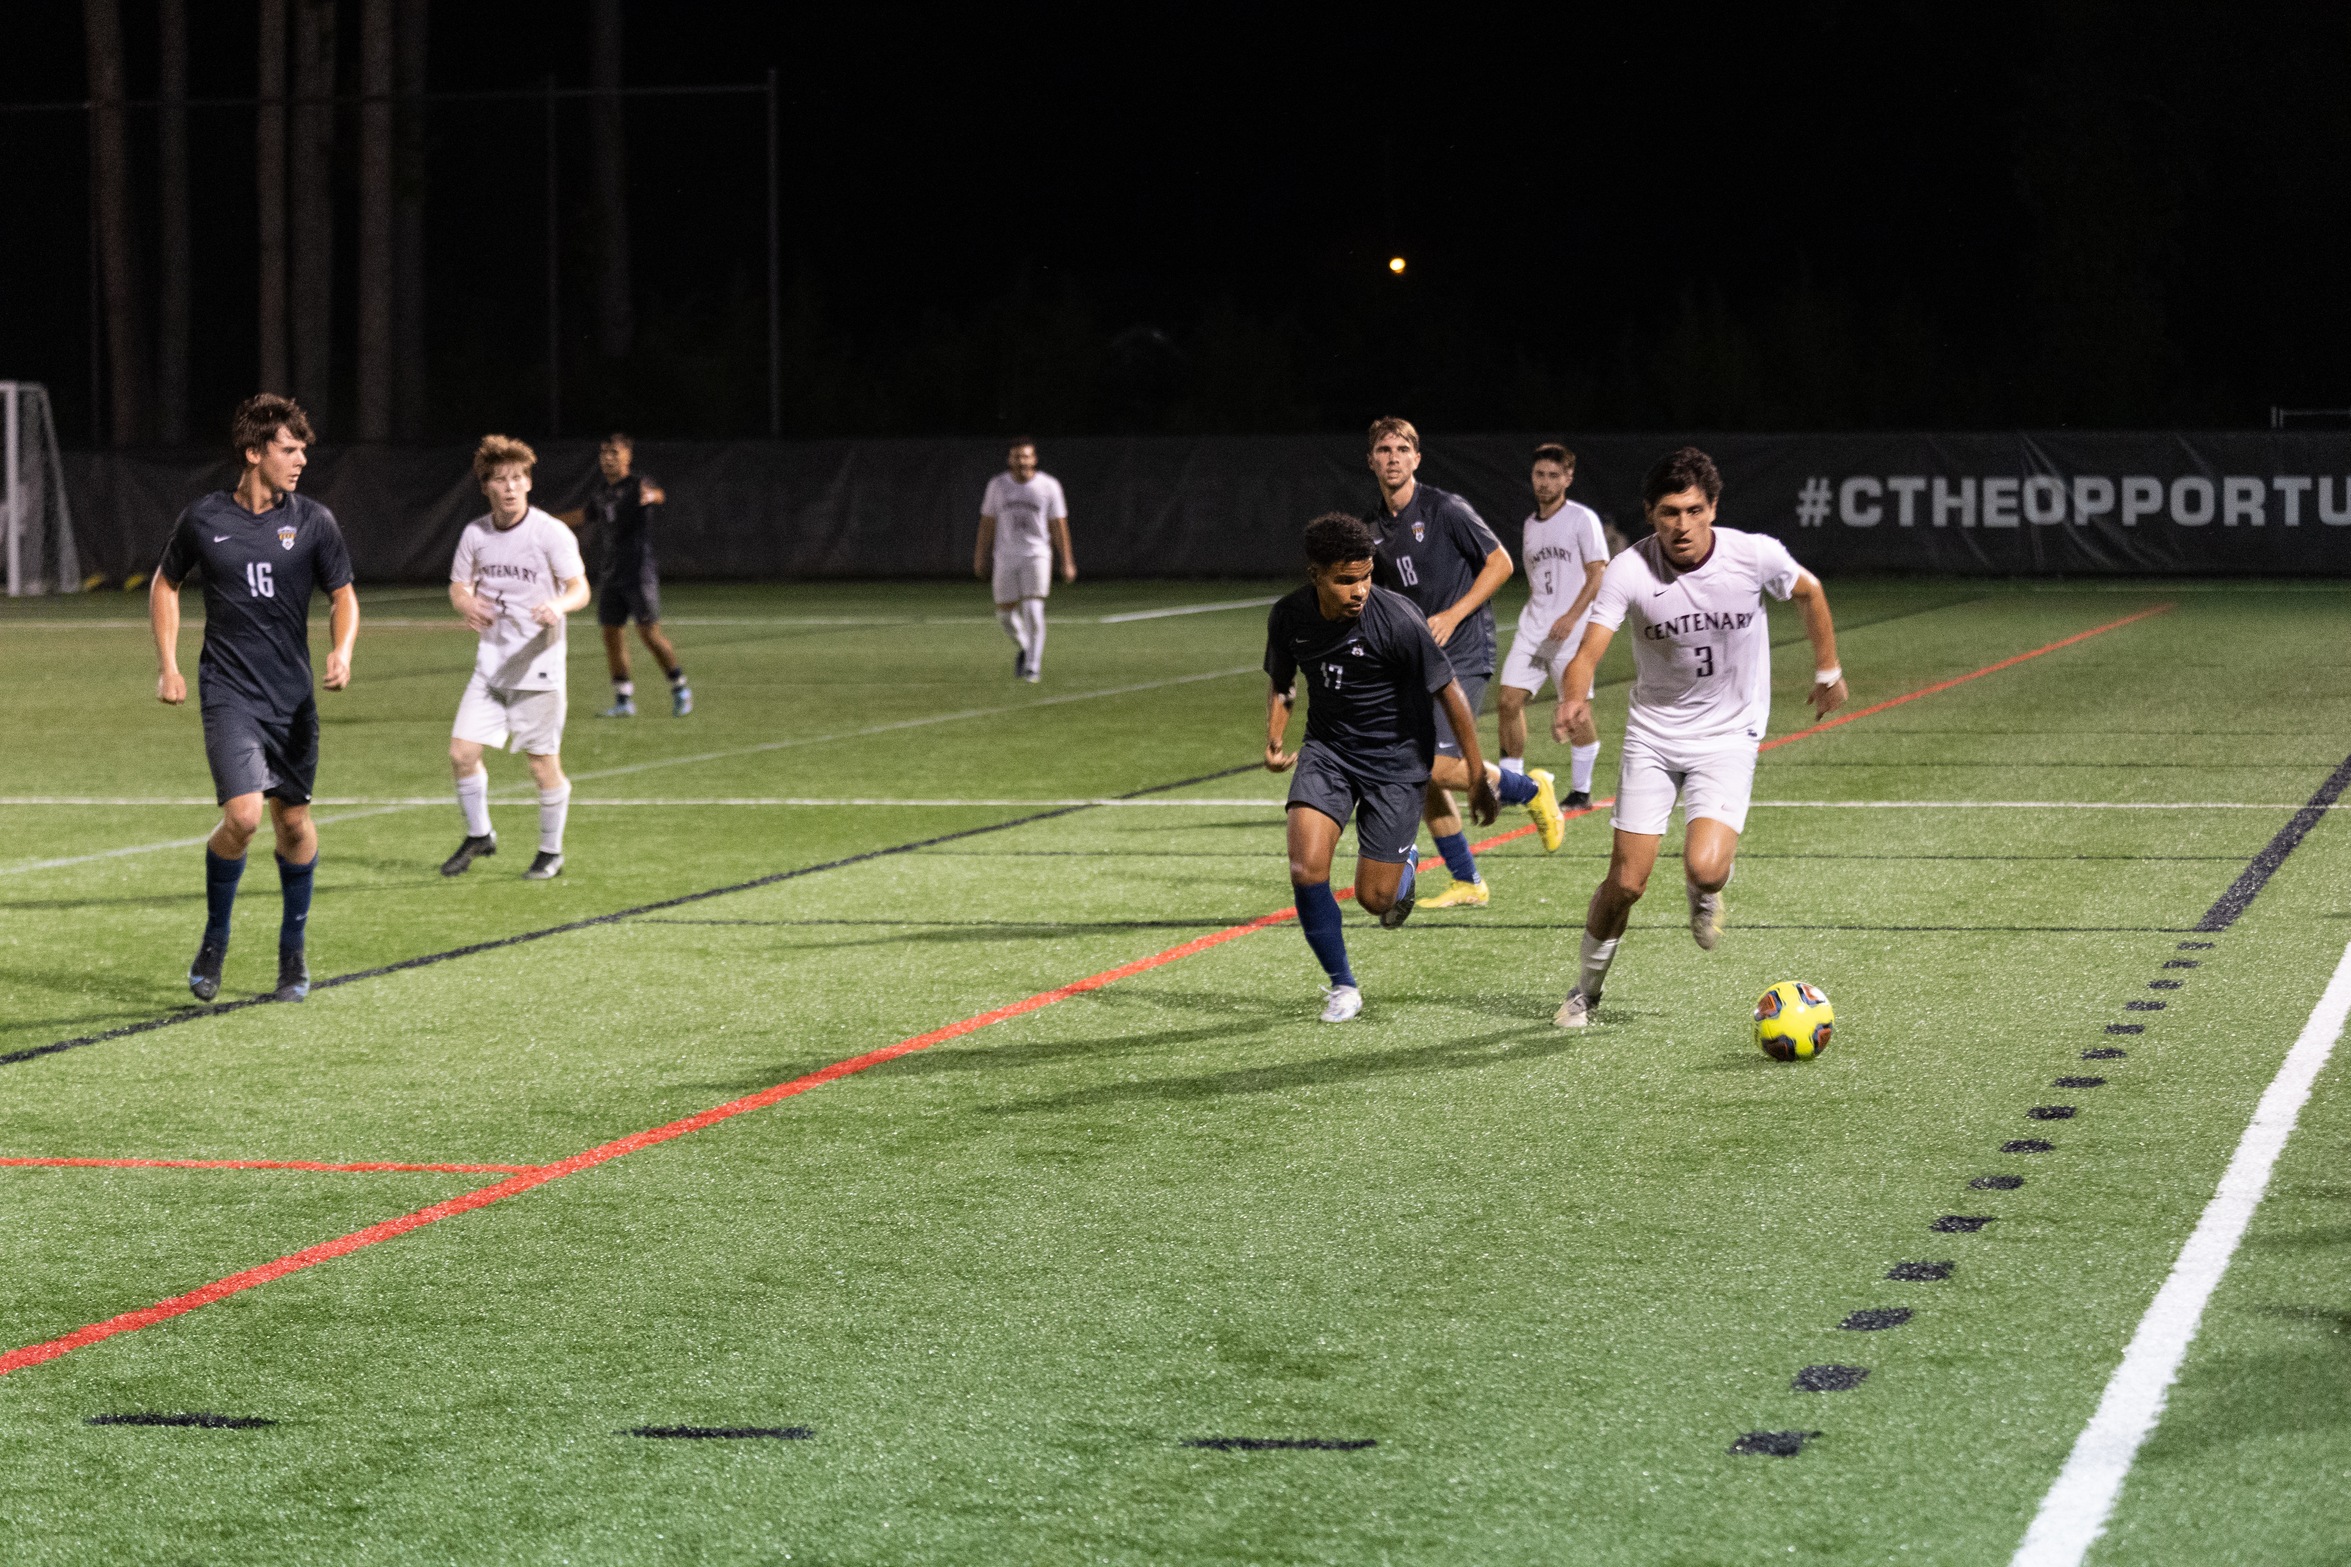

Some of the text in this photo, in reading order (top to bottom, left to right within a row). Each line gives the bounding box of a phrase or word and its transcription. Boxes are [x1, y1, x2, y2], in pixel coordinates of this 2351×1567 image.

[1796, 476, 2351, 527] #CTHEOPPORTU
[246, 562, 275, 598] 16
[479, 564, 538, 584] NTENARY
[1396, 555, 1419, 587] 18
[1644, 612, 1755, 640] CENTENARY
[1320, 661, 1343, 690] 17
[1694, 646, 1714, 678] 3
